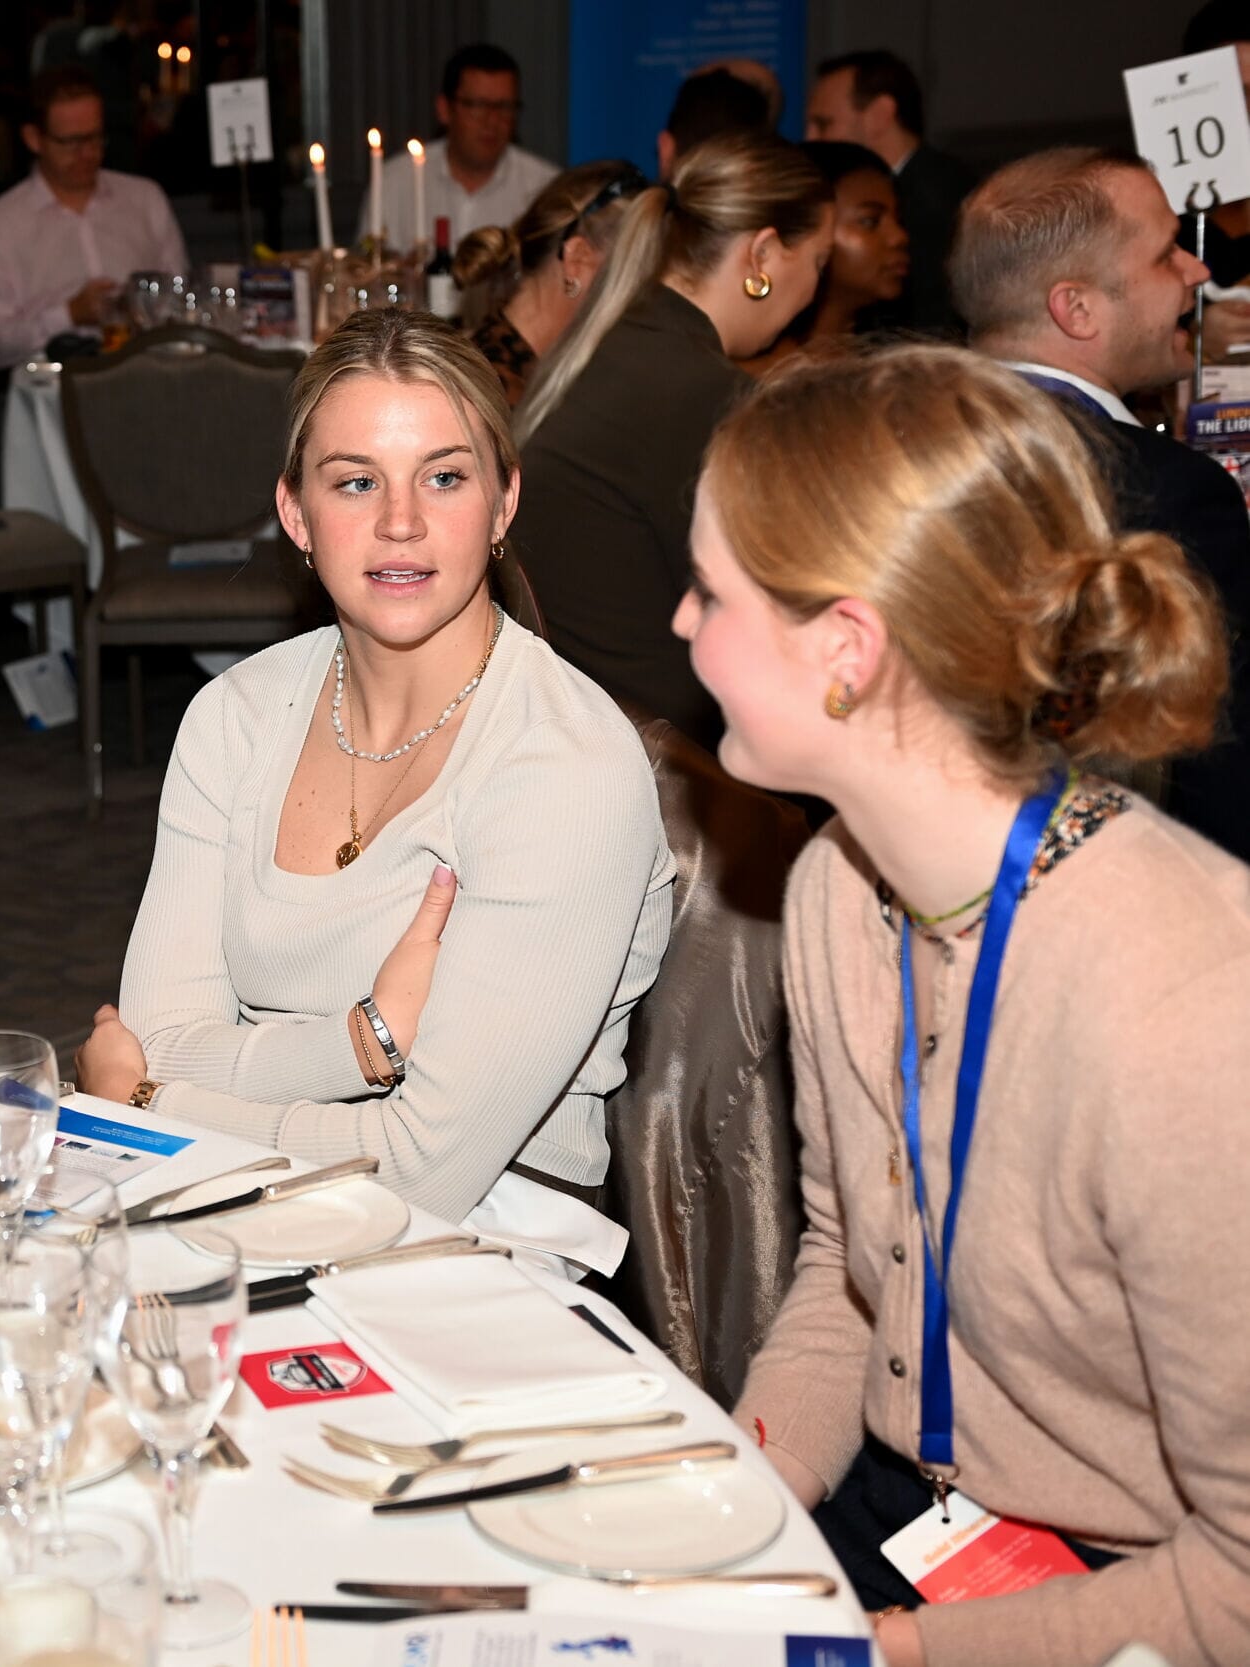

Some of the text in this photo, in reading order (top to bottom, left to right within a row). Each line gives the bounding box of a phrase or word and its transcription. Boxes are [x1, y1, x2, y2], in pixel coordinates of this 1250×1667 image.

[1166, 116, 1225, 167] 10
[1196, 417, 1250, 434] THE LIO
